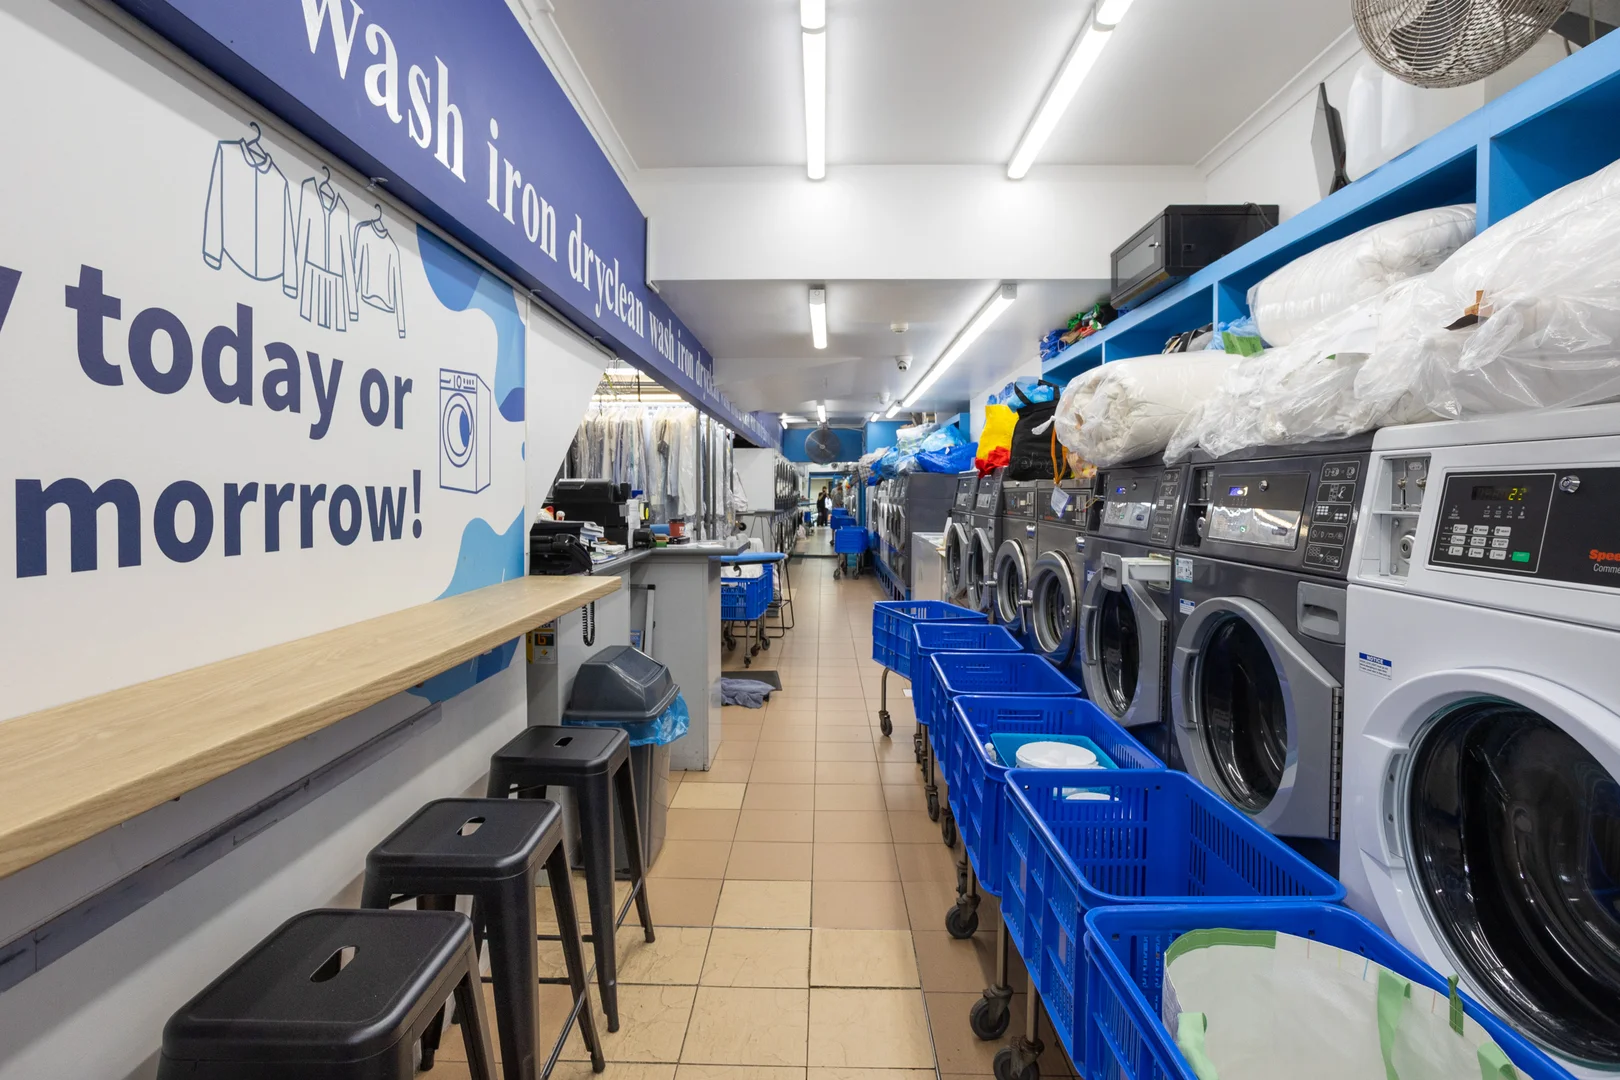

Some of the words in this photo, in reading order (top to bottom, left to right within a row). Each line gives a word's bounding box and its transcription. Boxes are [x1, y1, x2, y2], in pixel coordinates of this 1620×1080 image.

[485, 118, 557, 262] iron
[568, 213, 645, 338] dryclean
[649, 311, 675, 364] wash
[677, 328, 694, 380] iron
[65, 264, 343, 440] today
[360, 368, 412, 429] or
[16, 469, 422, 578] morrrow!
[1589, 549, 1620, 562] Spee
[1366, 655, 1384, 665] NOTICE
